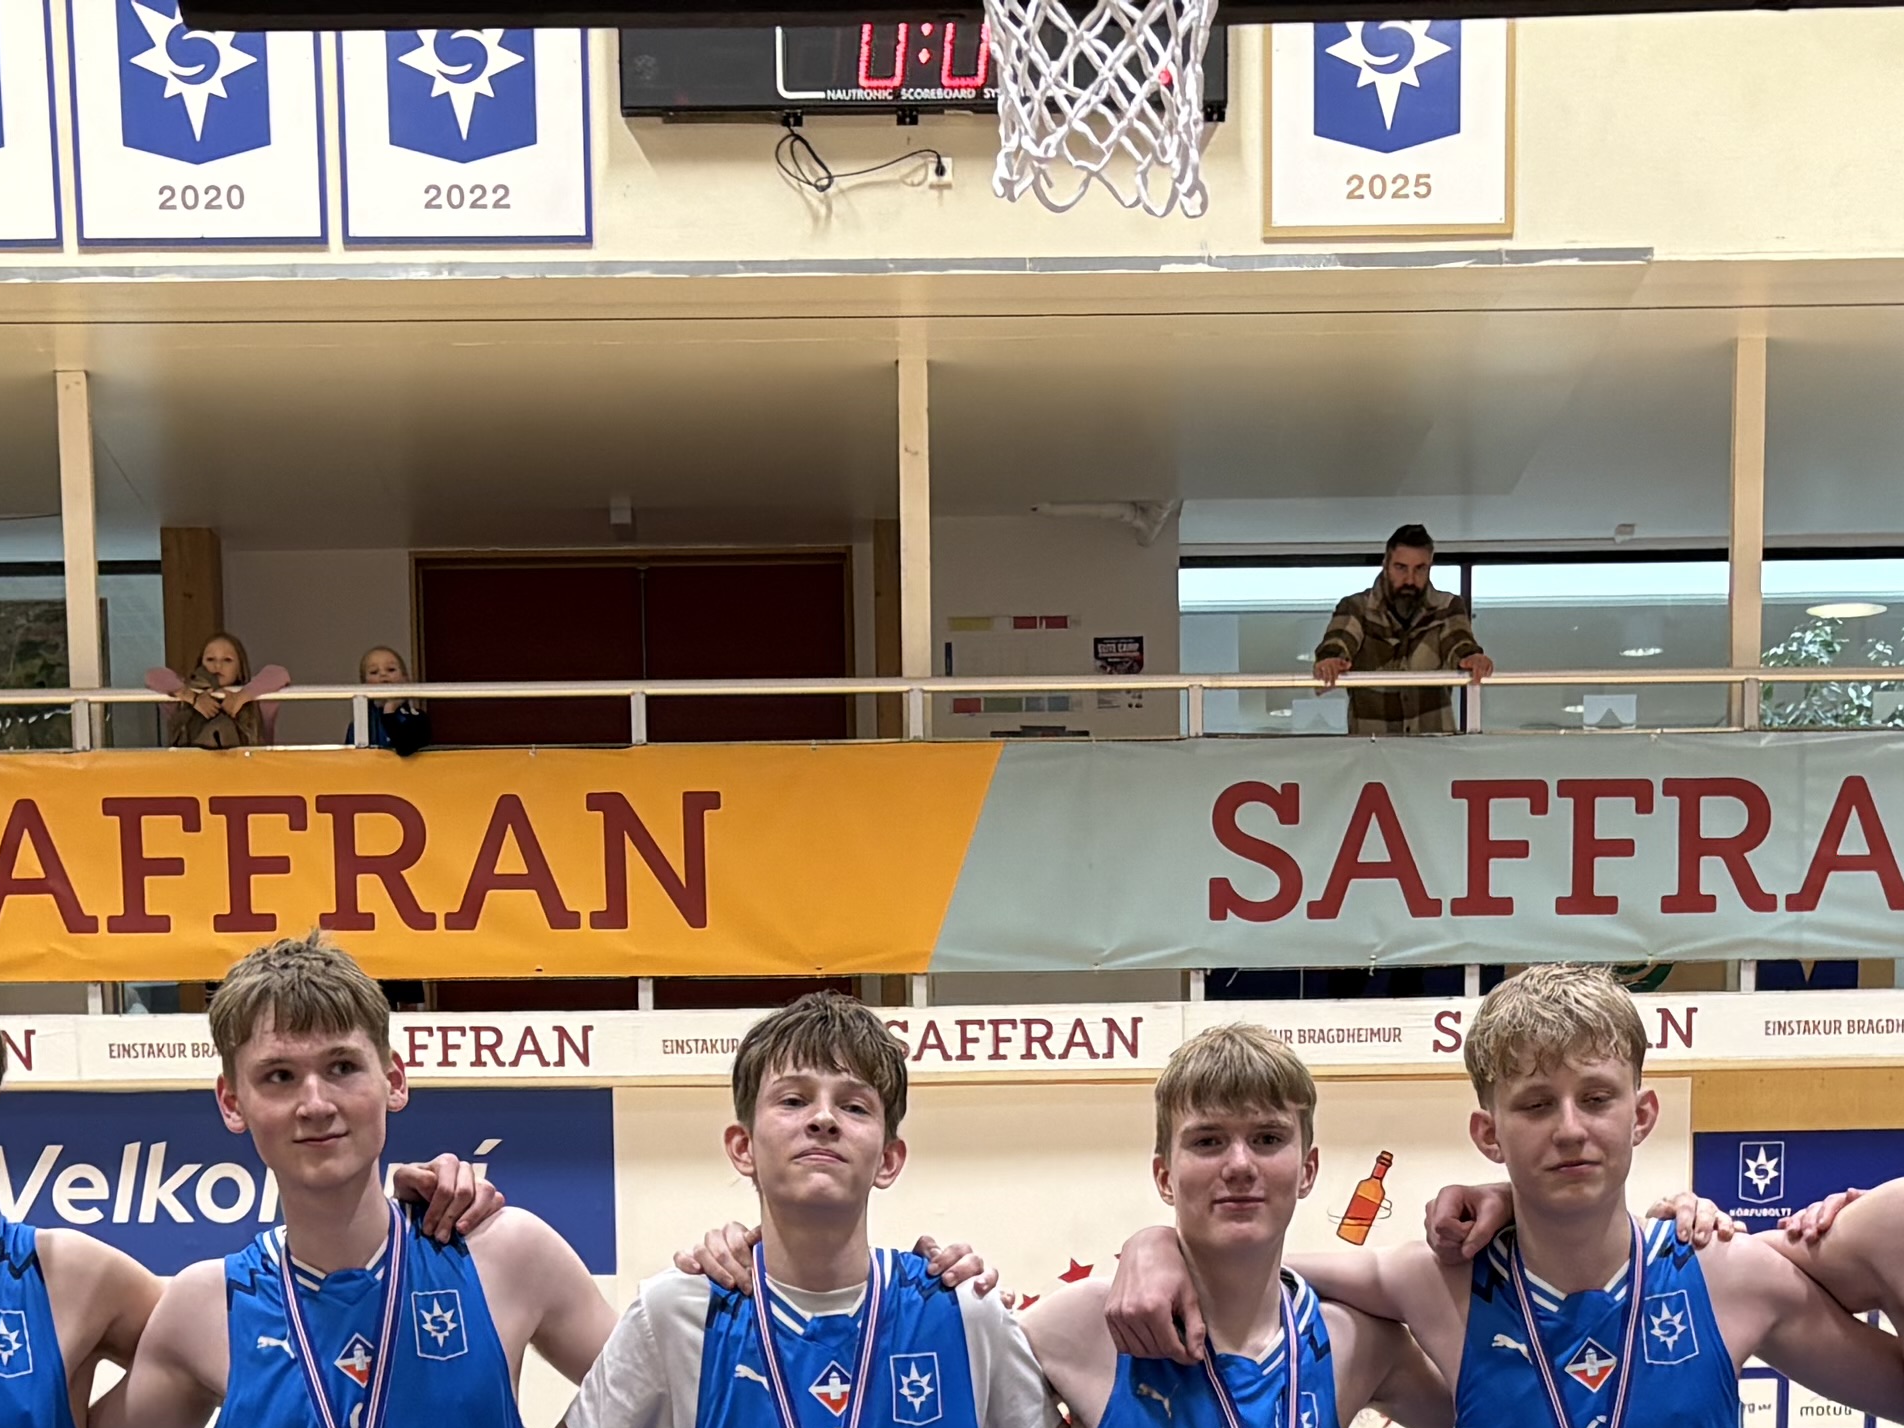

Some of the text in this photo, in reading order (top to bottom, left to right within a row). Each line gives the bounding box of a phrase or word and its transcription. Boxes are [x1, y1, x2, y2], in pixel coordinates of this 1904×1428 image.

[826, 89, 894, 100] NAUTRONIC
[900, 89, 976, 100] SCOREBOARD
[157, 183, 246, 212] 2020
[422, 182, 512, 211] 2022
[1345, 172, 1434, 201] 2025
[1764, 1018, 1843, 1037] EINSTAKUR
[107, 1041, 187, 1060] EINSTAKUR
[402, 1024, 595, 1068] FFRAN
[661, 1038, 740, 1056] EINSTAKUR
